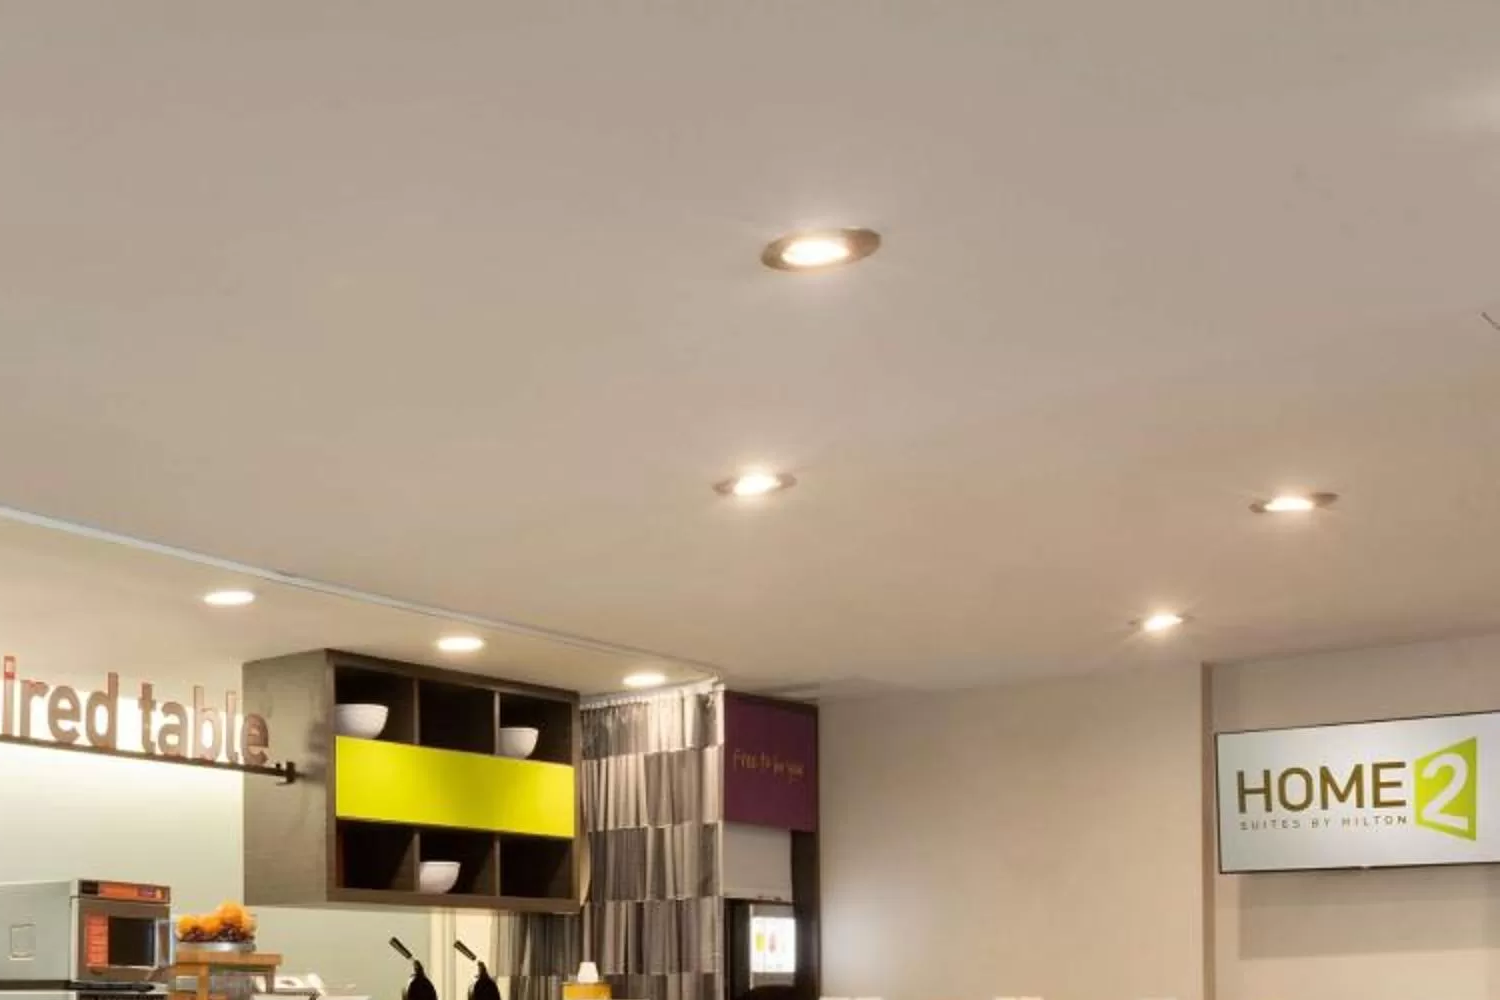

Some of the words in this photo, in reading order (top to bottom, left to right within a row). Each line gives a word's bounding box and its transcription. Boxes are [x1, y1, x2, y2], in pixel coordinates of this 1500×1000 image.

[138, 681, 271, 766] table
[1236, 761, 1407, 815] HOME
[1239, 817, 1302, 832] SUITES
[1311, 815, 1332, 830] BY
[1341, 814, 1408, 828] HILTON
